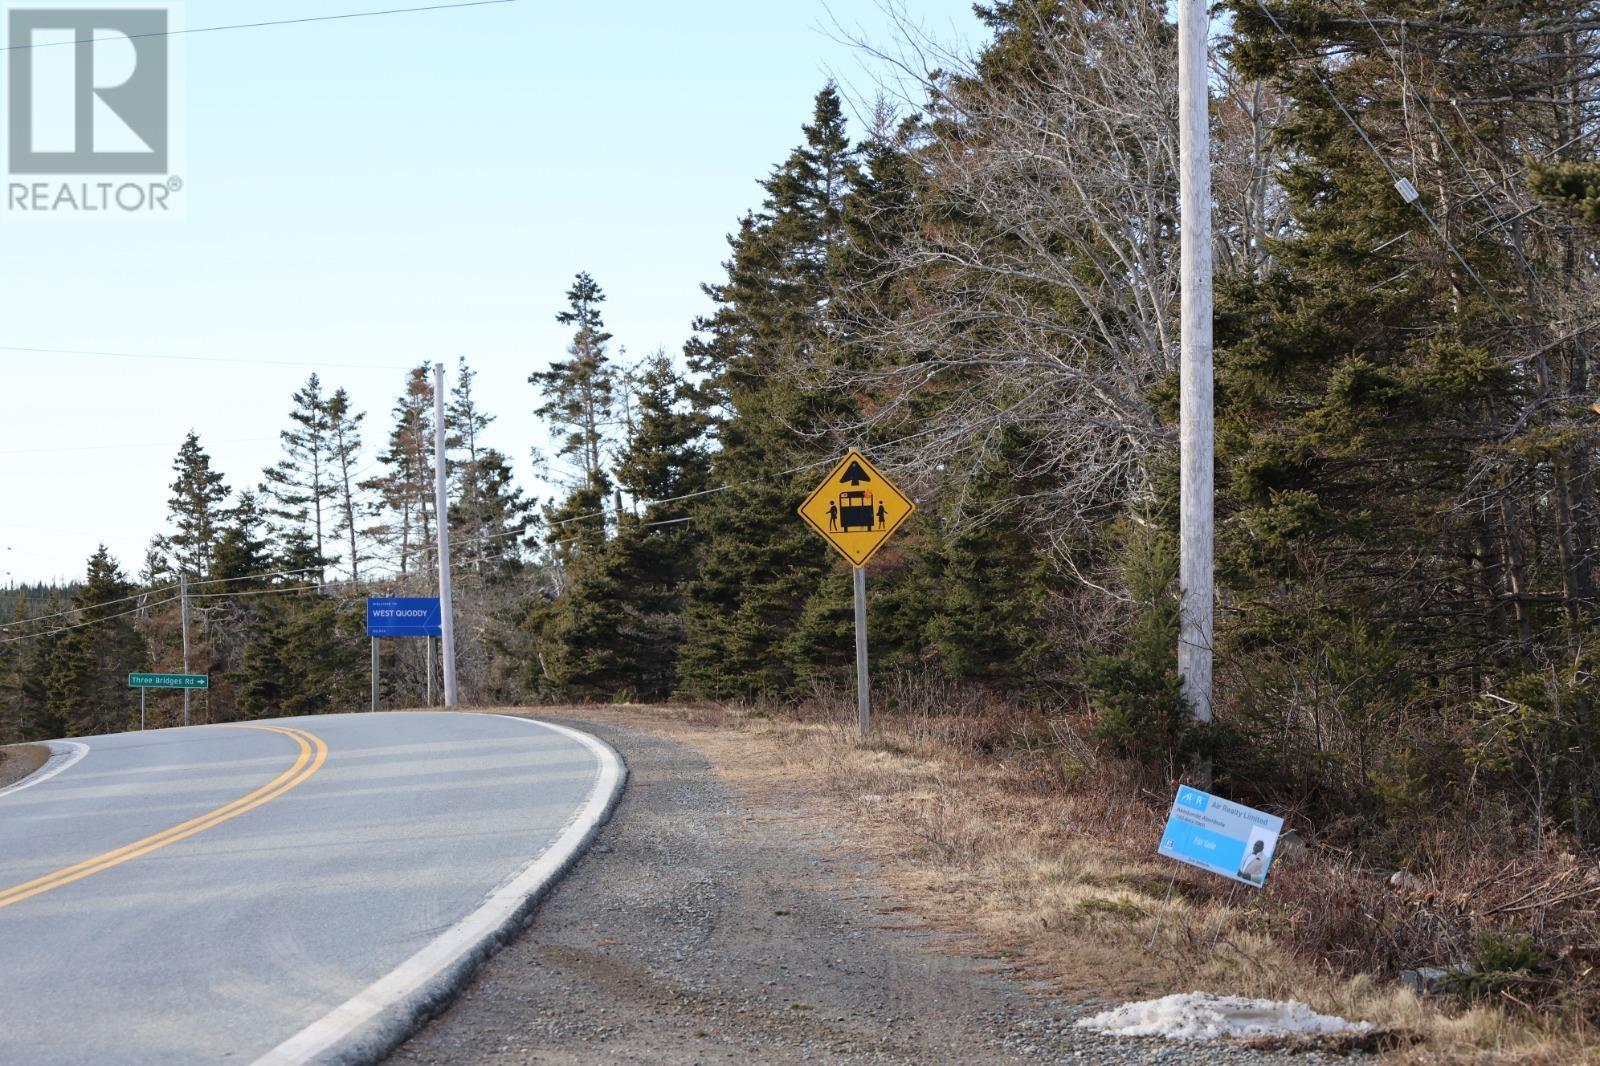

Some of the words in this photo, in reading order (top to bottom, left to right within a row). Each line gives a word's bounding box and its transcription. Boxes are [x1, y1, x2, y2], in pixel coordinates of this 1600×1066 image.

[372, 609, 394, 617] WEST
[395, 609, 428, 617] QUODDY
[132, 676, 153, 684] Three
[155, 677, 182, 686] Bridges
[1211, 800, 1222, 810] Air
[1222, 804, 1242, 818] Realty
[1243, 809, 1268, 826] Limited
